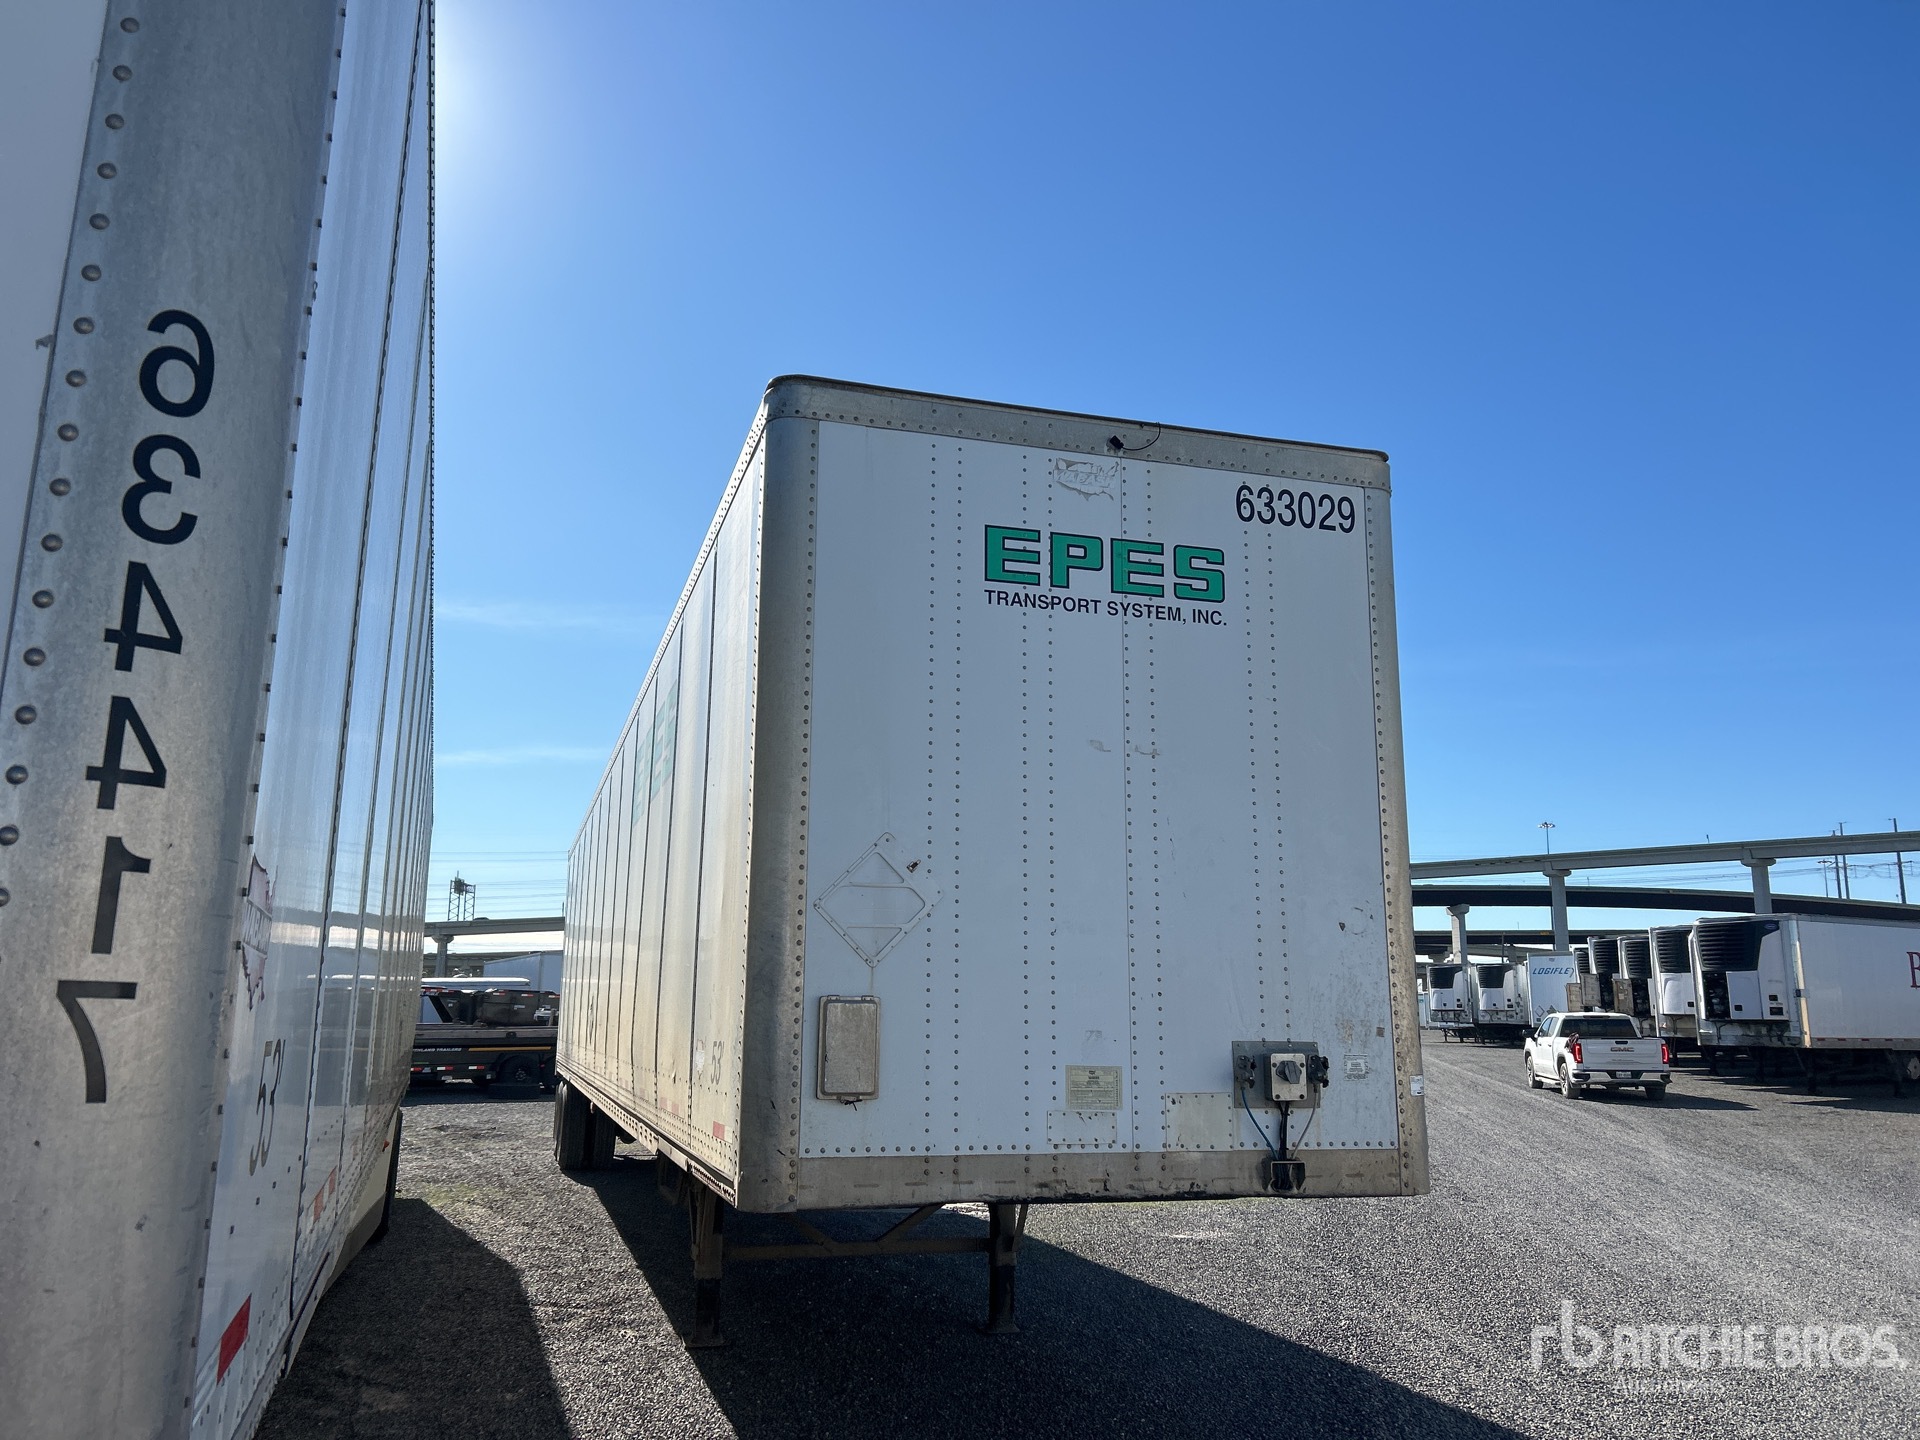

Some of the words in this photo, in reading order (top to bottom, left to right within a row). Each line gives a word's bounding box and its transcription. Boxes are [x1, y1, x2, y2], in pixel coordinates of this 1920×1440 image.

[1235, 484, 1356, 534] 633029
[984, 524, 1226, 603] EPES
[984, 589, 1101, 614] TRANSPORT
[1107, 600, 1187, 625] SYSTEM,
[1192, 608, 1228, 626] INC.
